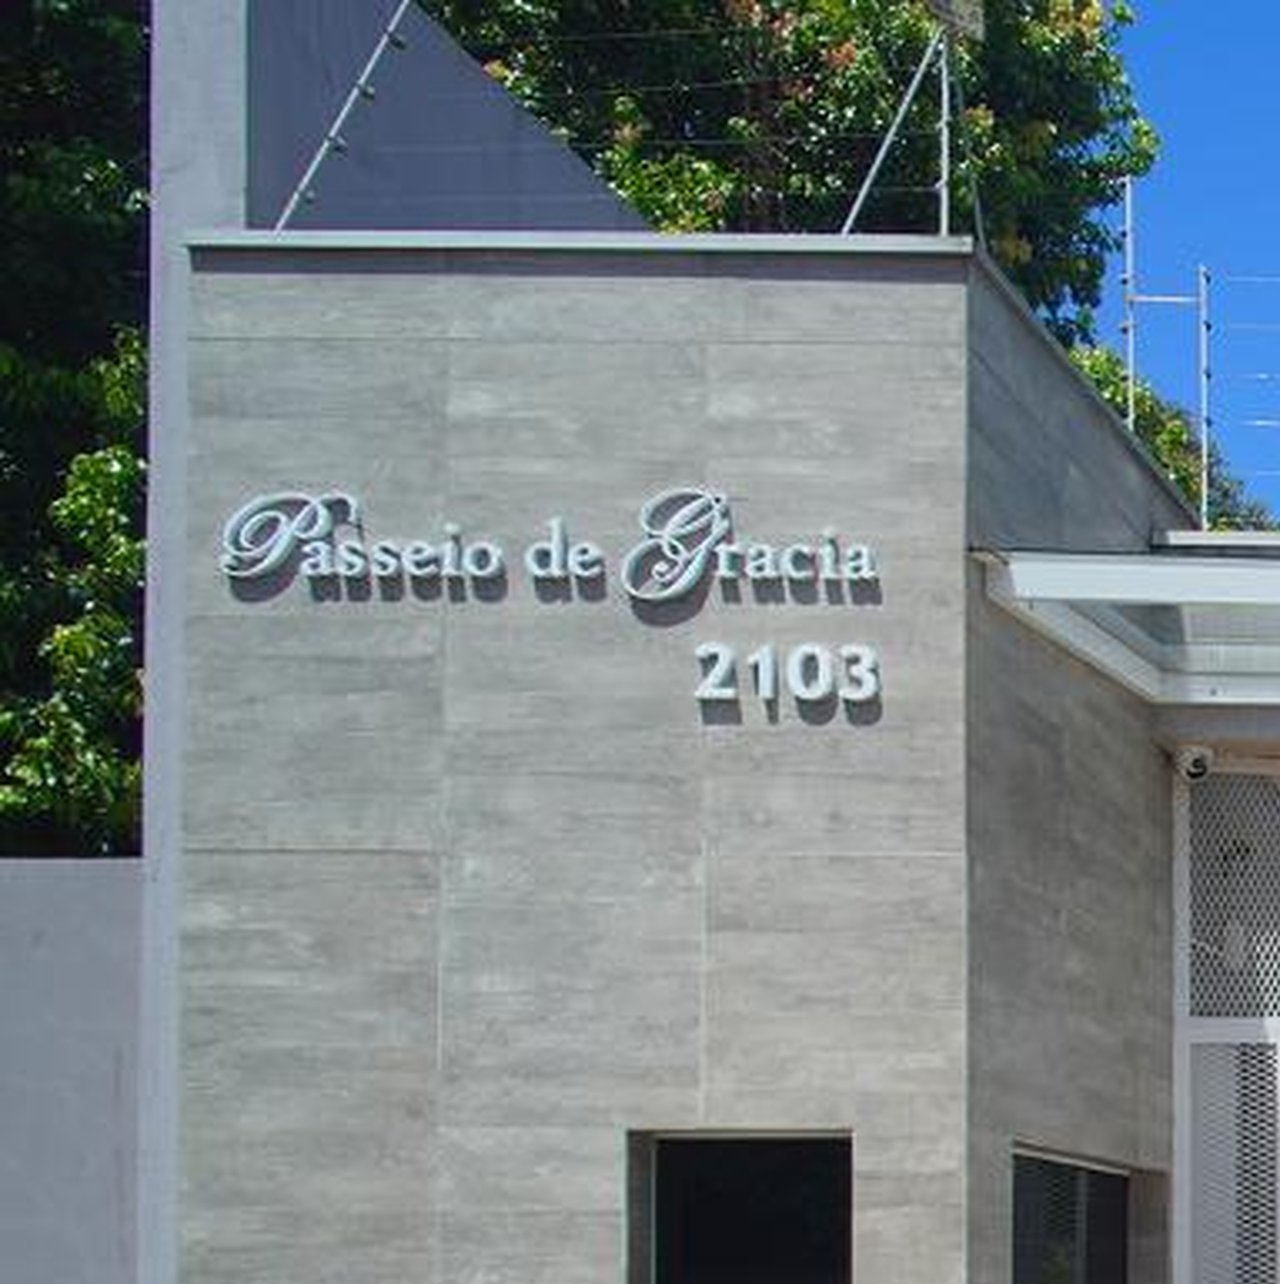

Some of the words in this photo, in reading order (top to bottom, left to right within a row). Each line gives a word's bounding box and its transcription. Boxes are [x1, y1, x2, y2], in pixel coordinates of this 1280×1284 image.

[221, 491, 503, 580] Passeio
[525, 516, 604, 578] de
[620, 487, 878, 601] Gracia
[694, 640, 881, 700] 2103
